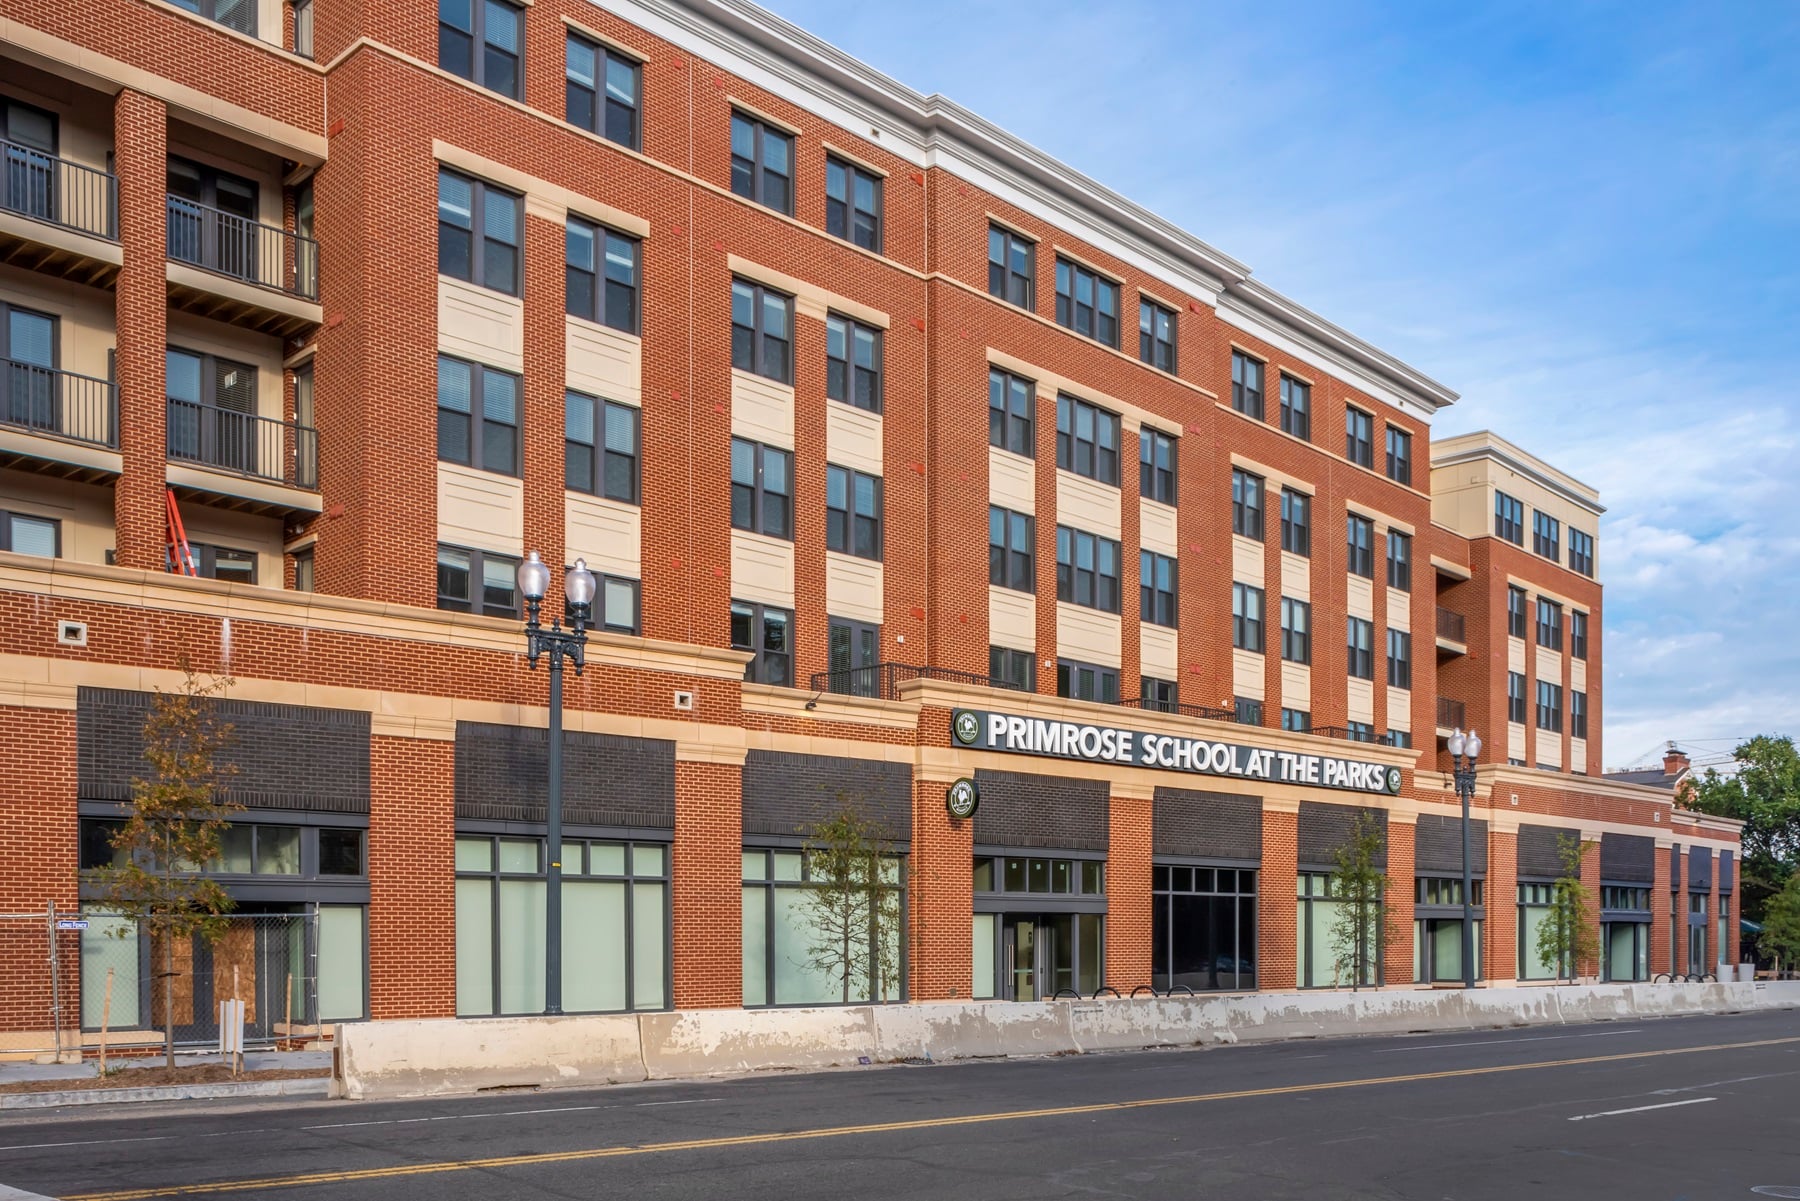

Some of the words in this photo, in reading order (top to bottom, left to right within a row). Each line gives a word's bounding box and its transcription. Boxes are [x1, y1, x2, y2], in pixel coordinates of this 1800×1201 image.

[987, 714, 1133, 761] PRIMROSE
[1141, 734, 1242, 775] SCHOOL
[1244, 749, 1275, 778] AT
[1278, 753, 1319, 783] THE
[1323, 758, 1385, 791] PARKS
